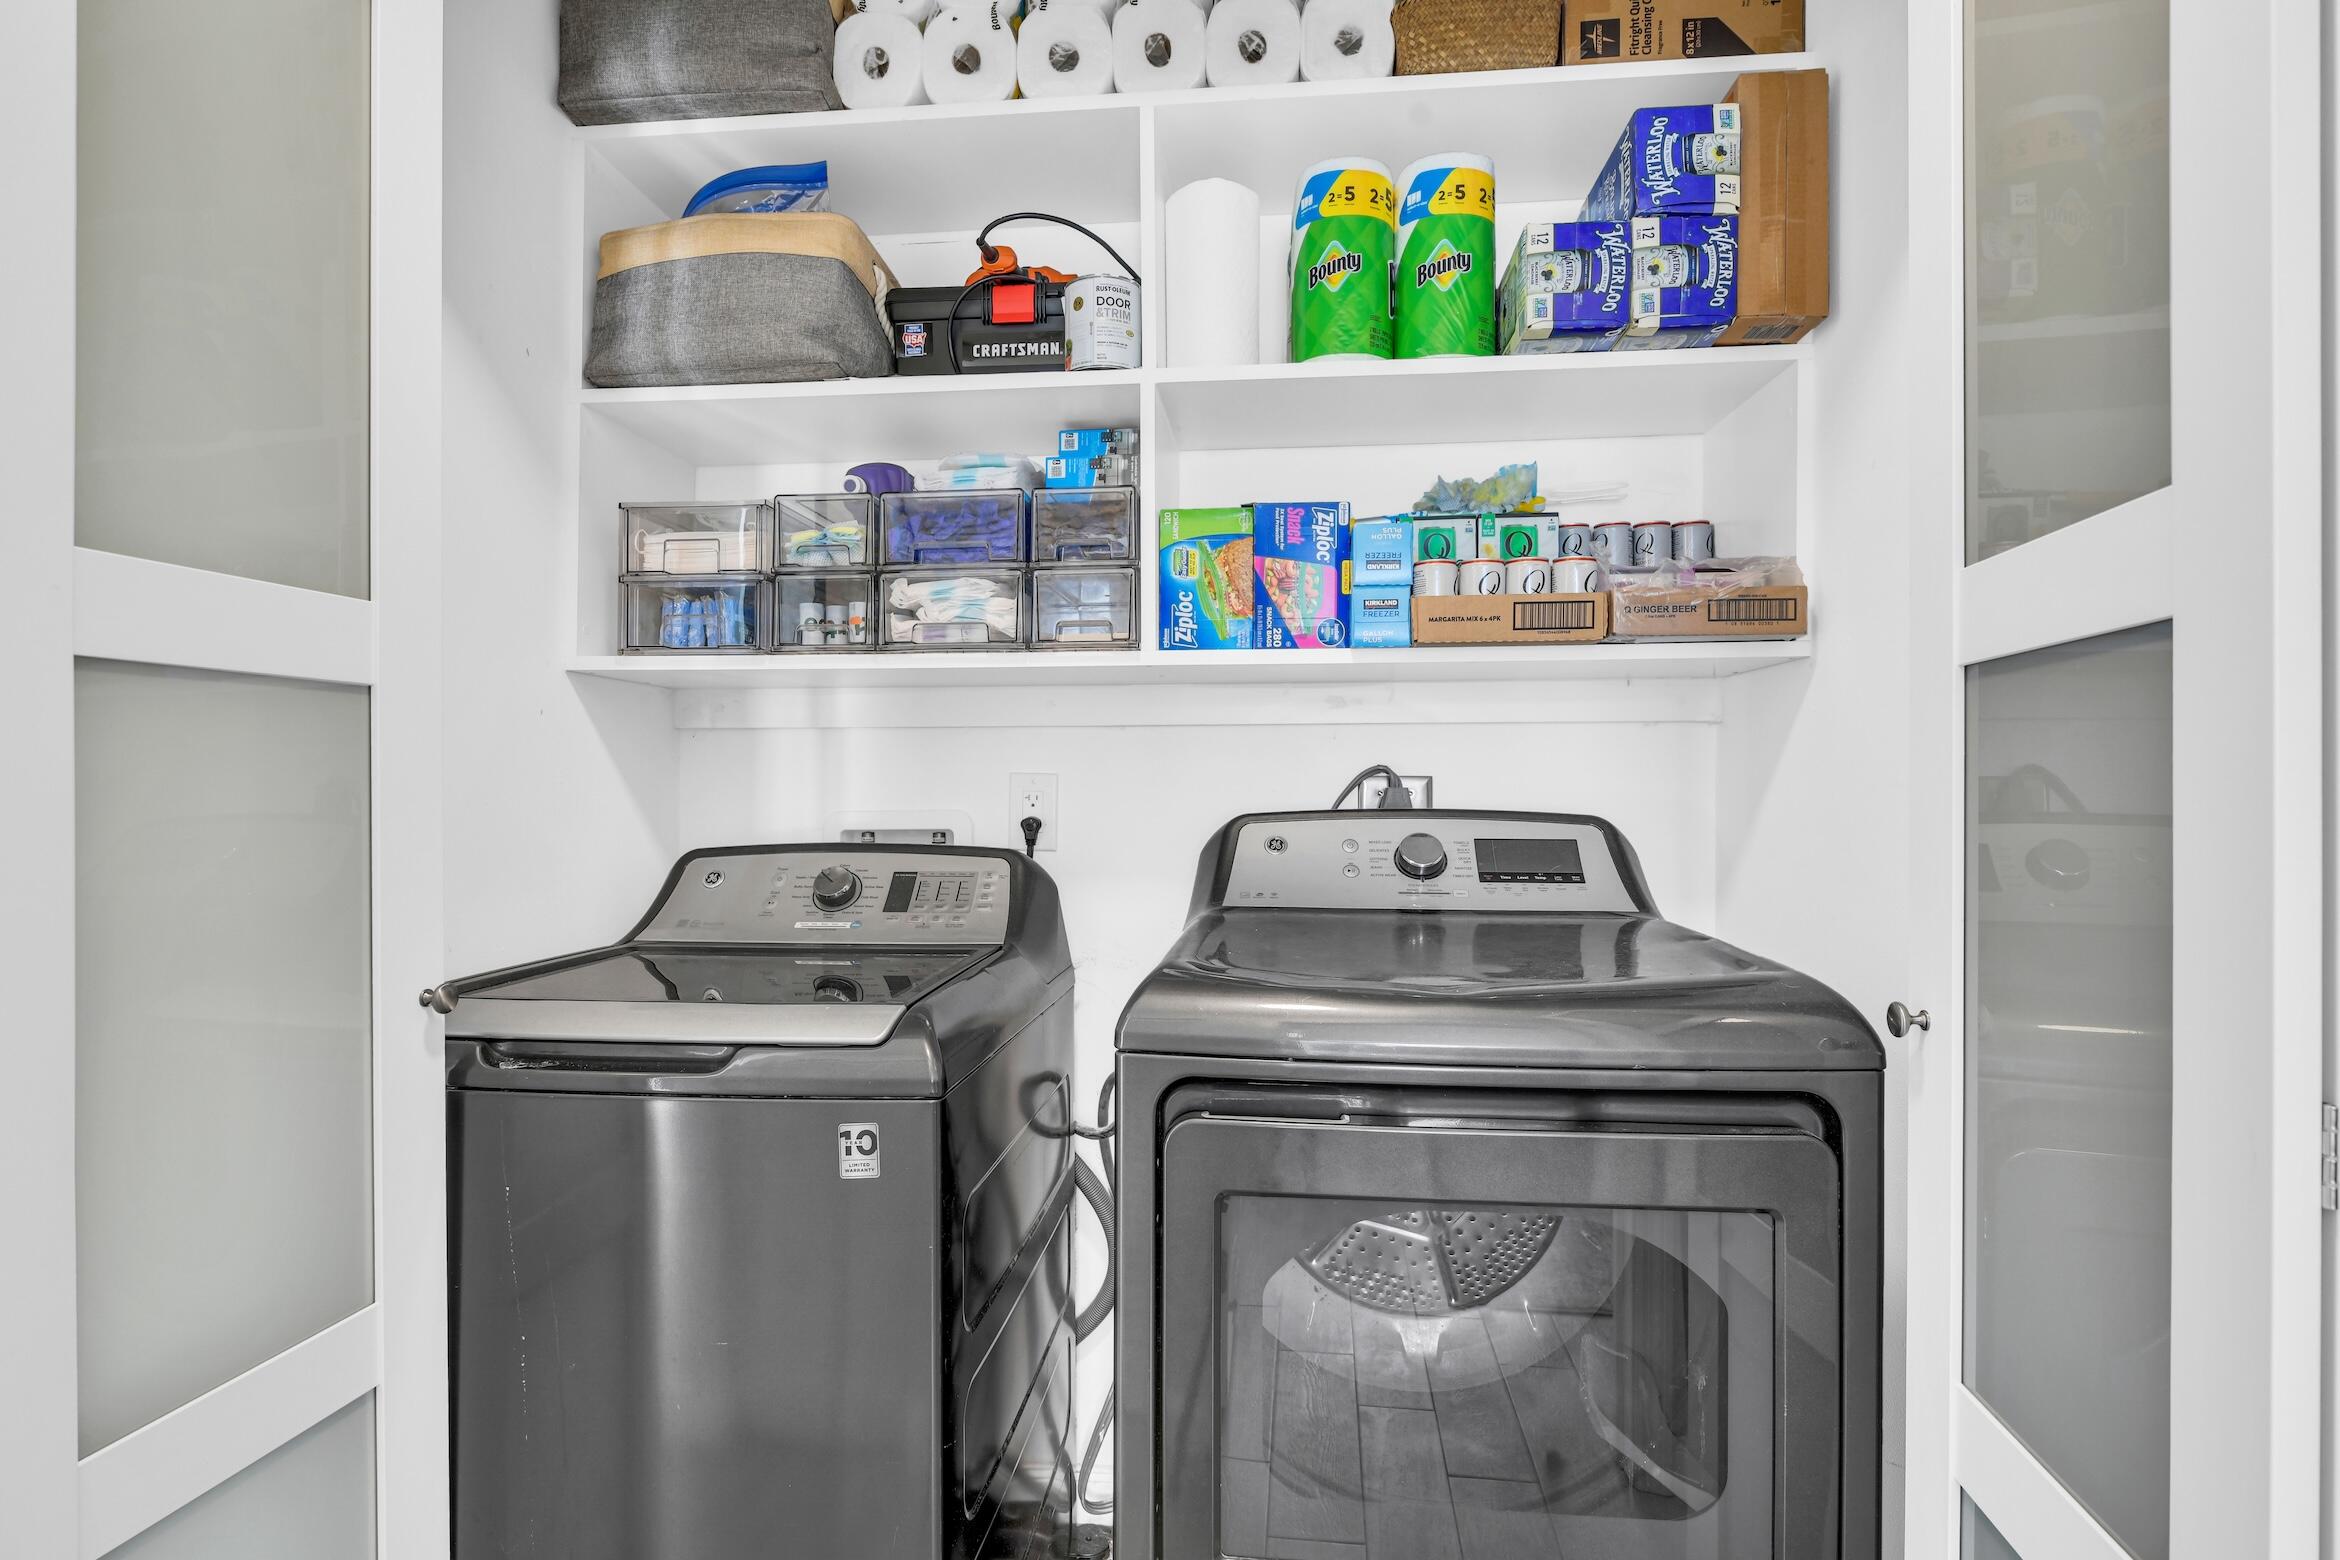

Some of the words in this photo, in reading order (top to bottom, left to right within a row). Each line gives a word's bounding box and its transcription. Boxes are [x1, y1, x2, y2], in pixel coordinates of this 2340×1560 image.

[1596, 23, 1604, 55] MEDLINE
[1629, 17, 1642, 56] Fitright
[1641, 6, 1655, 55] Cleansing
[1685, 31, 1695, 56] 8x12
[1641, 117, 1681, 206] WATERLOO
[1692, 135, 1711, 175] WATERLOO
[1720, 182, 1732, 195] 12
[1537, 232, 1549, 245] 12
[1642, 226, 1655, 239] 12
[1309, 252, 1361, 290] Bounty
[1417, 252, 1472, 290] Bounty
[1560, 252, 1580, 291] WATERLOO
[1596, 223, 1631, 312] WATERLOO
[1666, 245, 1686, 285] WATERLOO
[1702, 218, 1738, 307] WATERLOO
[1096, 296, 1131, 310] DOOR
[905, 334, 923, 344] USA
[1287, 507, 1305, 545] Snack
[1311, 512, 1335, 562] Ziploc
[1505, 531, 1533, 558] Q
[1562, 533, 1582, 556] Q
[1636, 533, 1655, 555] Q
[1478, 570, 1501, 595] Q
[1523, 569, 1546, 594] Q
[1173, 591, 1198, 643] Ziploc
[1362, 610, 1400, 618] FREEZER
[1624, 605, 1632, 613] Q
[1633, 605, 1670, 613] GINGER
[1671, 604, 1697, 613] BEER
[1273, 628, 1282, 647] 280
[840, 1129, 878, 1156] 10
